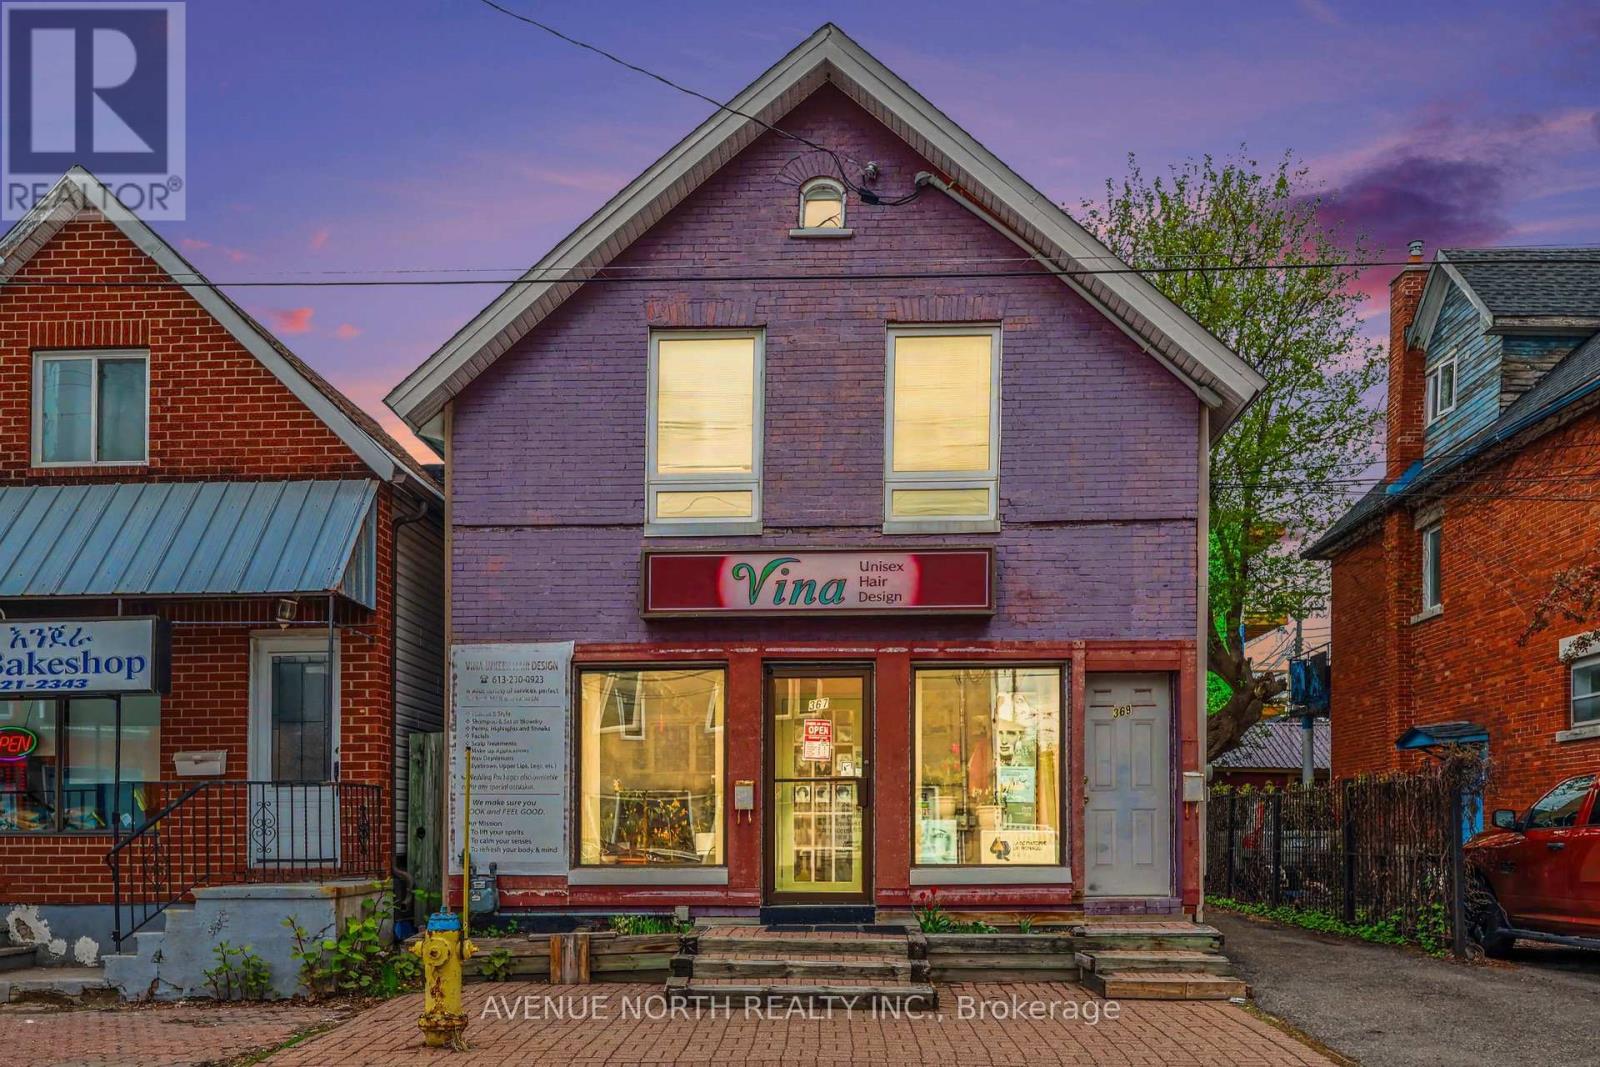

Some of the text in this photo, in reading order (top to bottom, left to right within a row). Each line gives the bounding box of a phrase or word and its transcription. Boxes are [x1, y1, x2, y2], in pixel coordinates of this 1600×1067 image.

[859, 560, 905, 572] Unisex
[732, 557, 848, 606] Vina
[859, 575, 888, 588] Hair
[858, 591, 903, 603] Design
[531, 661, 559, 671] DESIGN
[809, 698, 829, 710] 367
[1113, 705, 1131, 718] 369
[808, 726, 829, 736] OPEN
